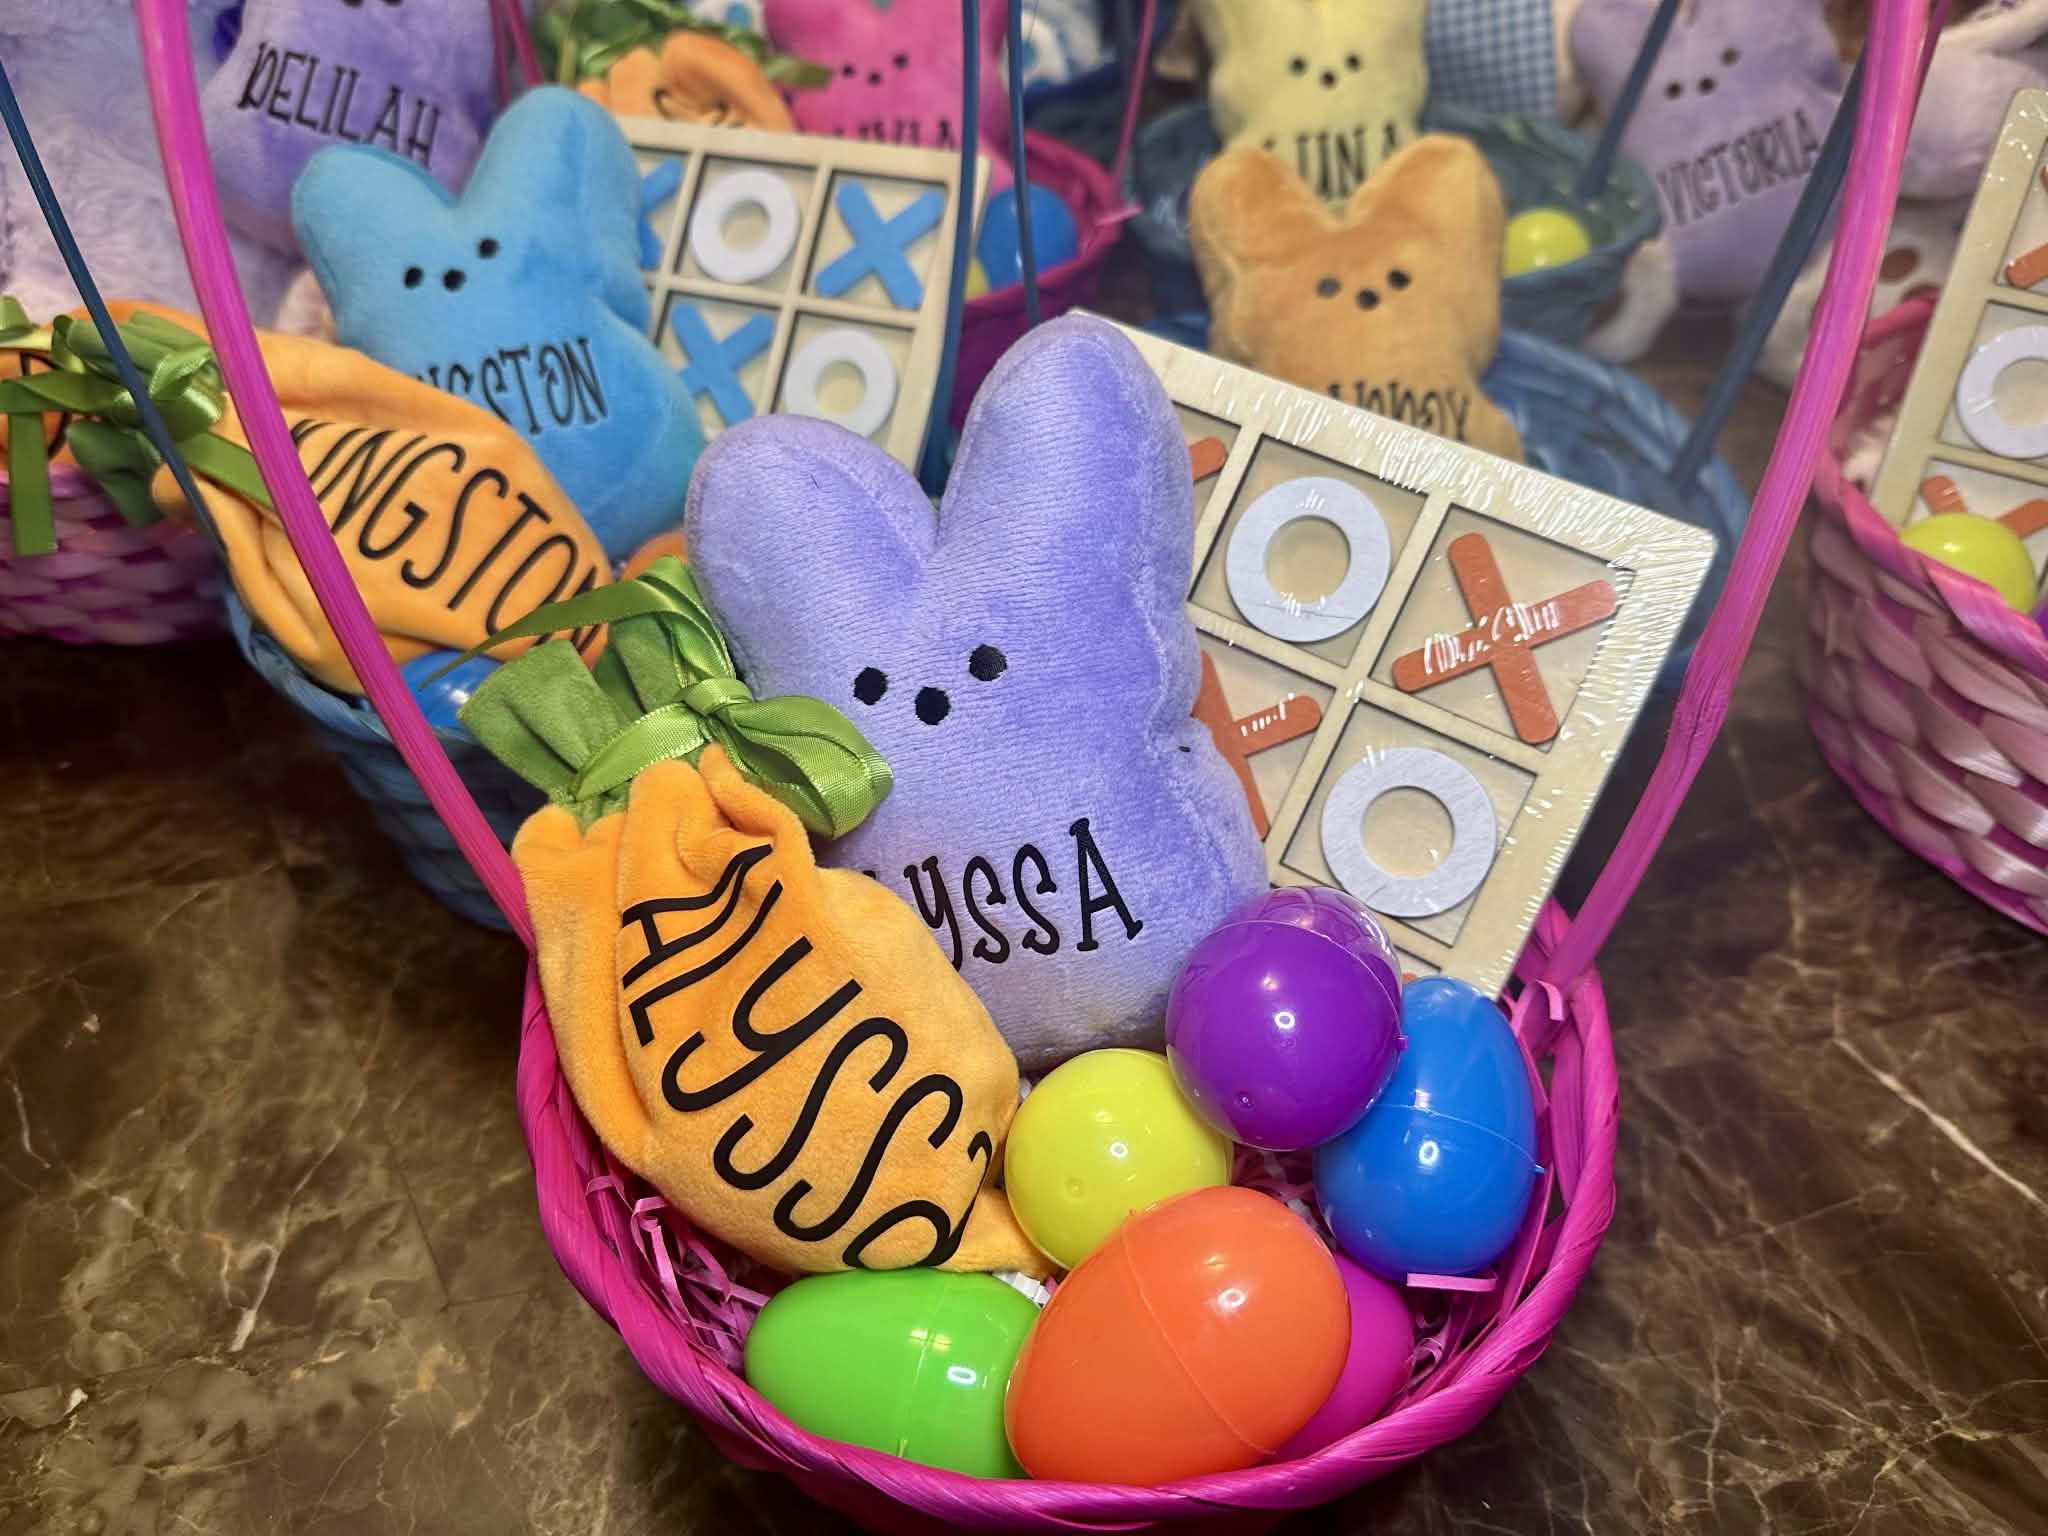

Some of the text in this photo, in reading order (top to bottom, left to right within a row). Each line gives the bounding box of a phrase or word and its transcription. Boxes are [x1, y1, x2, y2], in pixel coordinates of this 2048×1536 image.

[237, 41, 441, 168] DELILAH
[1656, 111, 1820, 226] VICTORIA
[417, 335, 608, 434] STON
[291, 418, 604, 656] INGSTO
[862, 817, 1144, 972] YSSA
